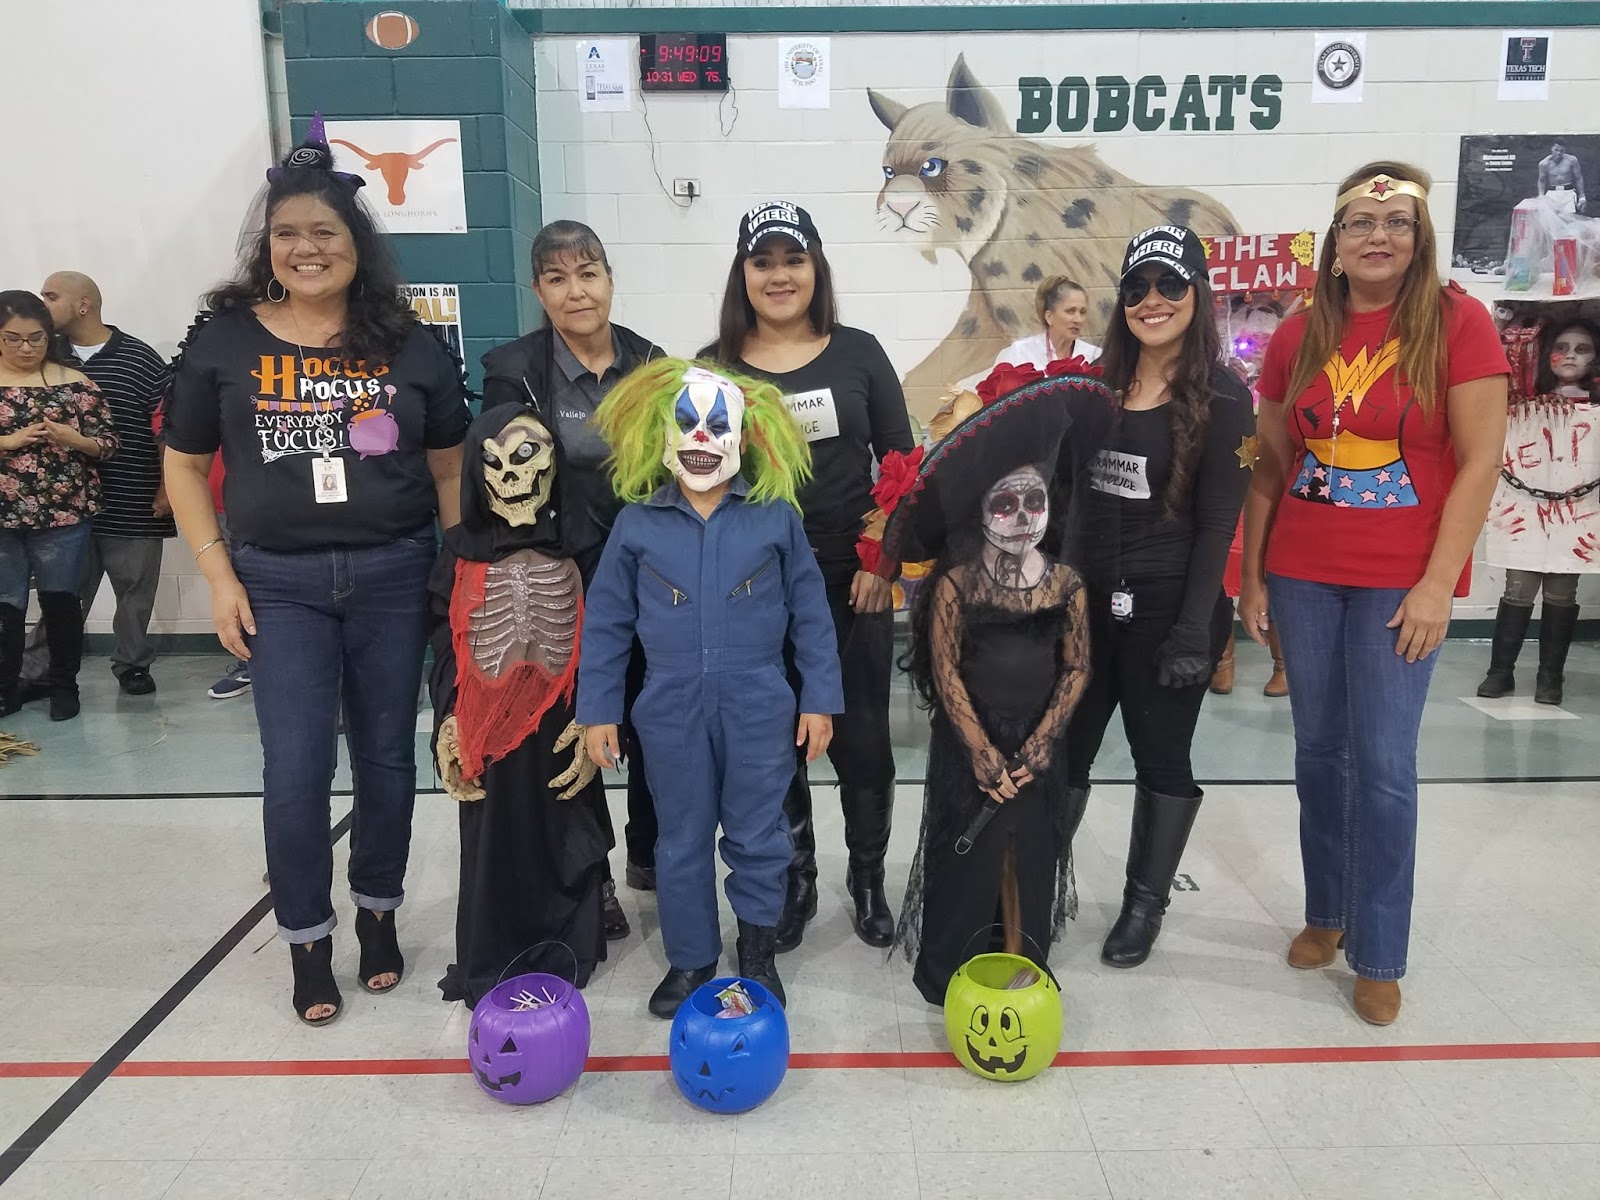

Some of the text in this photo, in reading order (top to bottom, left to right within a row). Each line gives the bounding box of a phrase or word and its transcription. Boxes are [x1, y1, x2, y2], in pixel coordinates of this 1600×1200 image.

[658, 45, 722, 62] 9:49:09
[1506, 64, 1546, 72] TEXAS TECH
[677, 71, 697, 82] WED
[1016, 74, 1283, 134] BOBCATS
[383, 210, 438, 218] LONGHORNS
[1213, 233, 1279, 261] THE
[1293, 238, 1310, 248] PLAY
[1207, 261, 1297, 292] CLAW
[429, 287, 439, 297] IS
[442, 287, 456, 297] AN
[300, 376, 381, 400] POCUS
[786, 396, 825, 412] MMAR
[254, 410, 344, 428] EVERYBODY
[559, 410, 586, 420] Vallejo
[257, 428, 344, 450] FOCUS!
